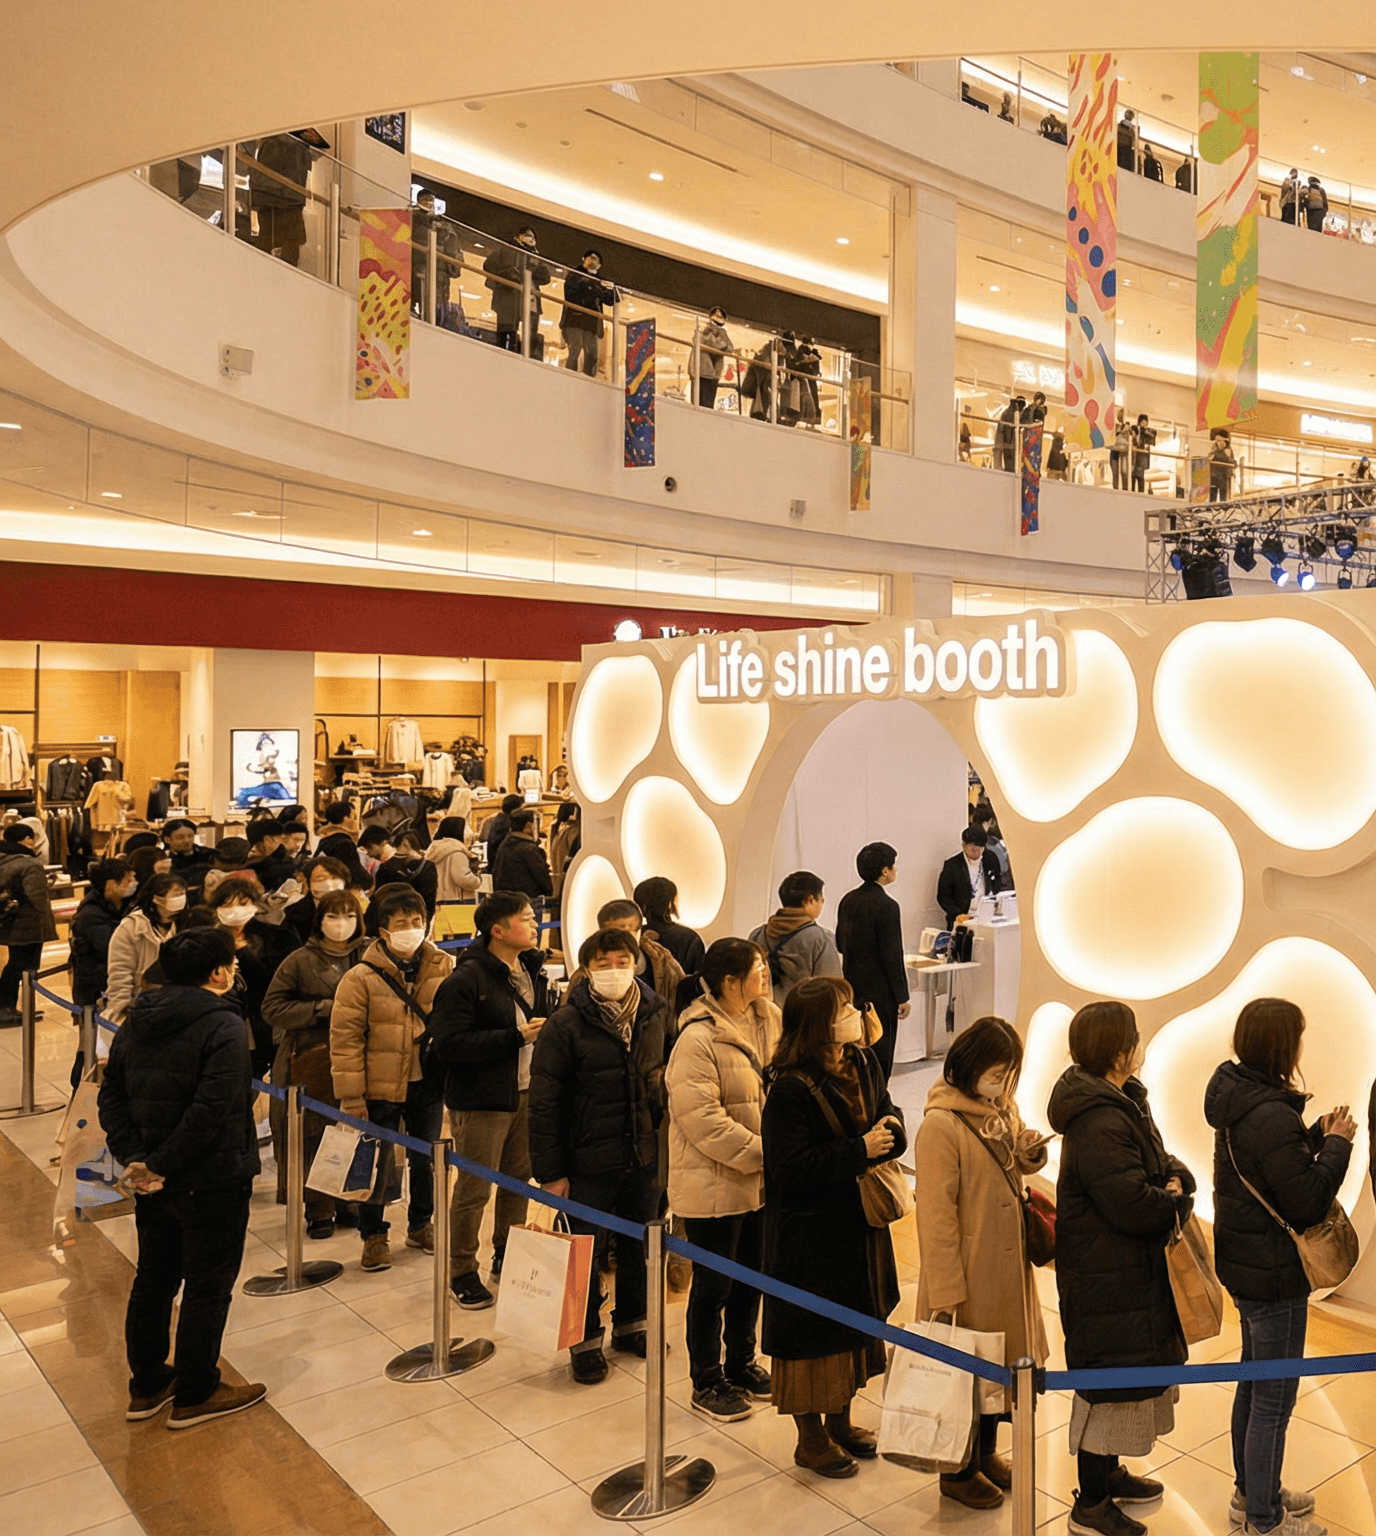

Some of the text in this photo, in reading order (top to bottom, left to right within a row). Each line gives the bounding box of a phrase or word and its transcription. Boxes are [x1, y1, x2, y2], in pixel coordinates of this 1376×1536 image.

[697, 619, 1059, 697] Life shine booth
